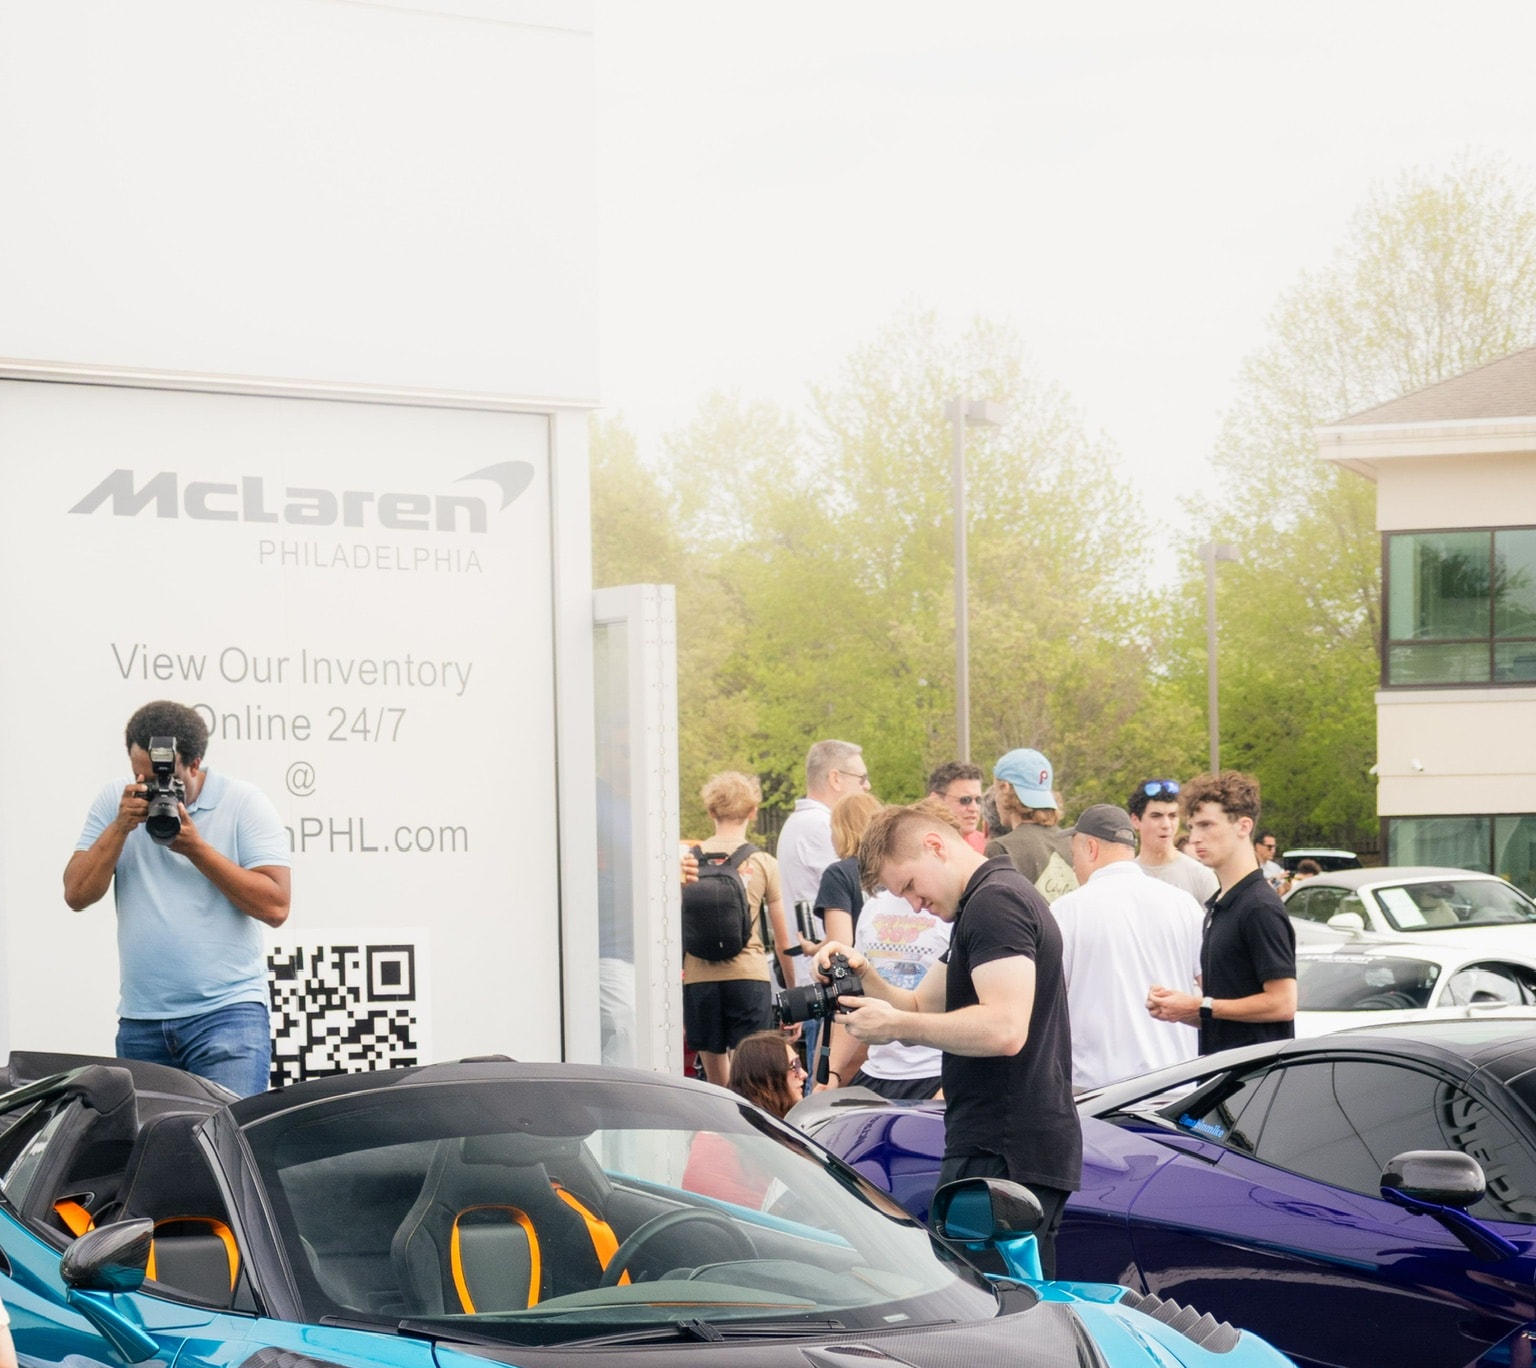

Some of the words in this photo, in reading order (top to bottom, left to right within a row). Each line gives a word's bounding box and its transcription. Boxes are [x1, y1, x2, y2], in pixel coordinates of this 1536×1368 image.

[67, 468, 488, 534] McLaren
[258, 539, 483, 574] PHILADELPHIA
[111, 642, 207, 681] View
[219, 646, 290, 684] Our
[301, 648, 473, 697] Inventory
[191, 703, 311, 742] Online
[327, 706, 406, 742] 24/7
[285, 760, 317, 798] @
[284, 816, 469, 854] nPHL.com
